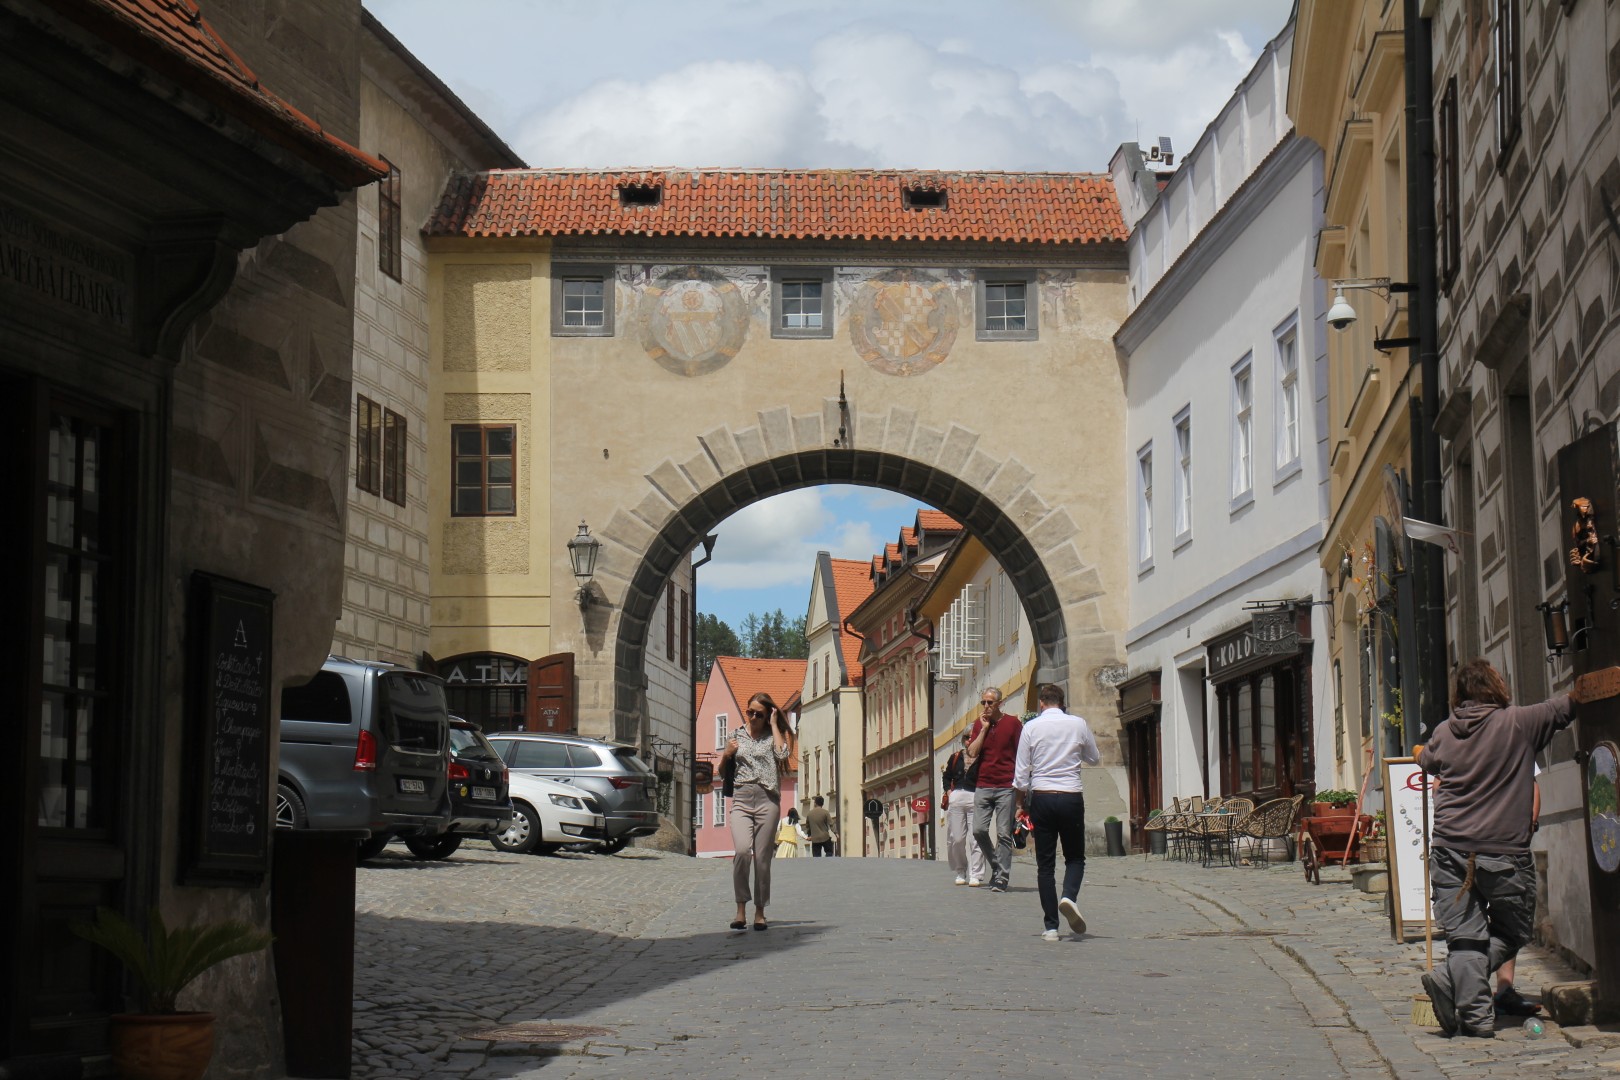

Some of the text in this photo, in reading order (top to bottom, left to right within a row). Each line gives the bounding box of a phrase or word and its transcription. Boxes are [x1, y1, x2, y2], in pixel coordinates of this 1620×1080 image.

[234, 619, 247, 643] A
[1220, 635, 1256, 667] KOLO
[446, 664, 522, 684] ATM
